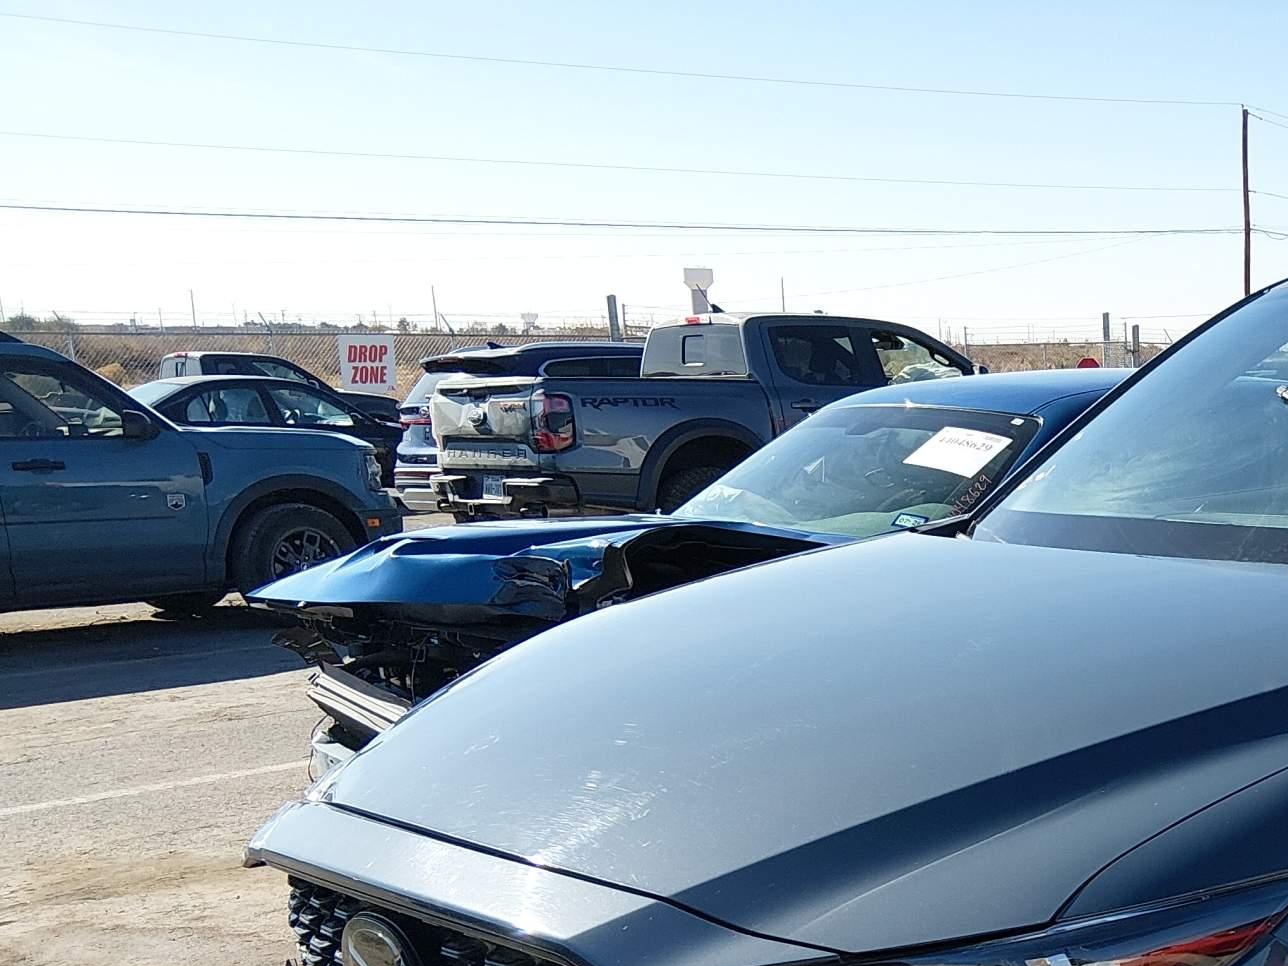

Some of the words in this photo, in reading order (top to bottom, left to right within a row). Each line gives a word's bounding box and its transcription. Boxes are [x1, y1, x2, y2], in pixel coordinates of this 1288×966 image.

[347, 344, 388, 363] DROP
[351, 365, 388, 385] ZONE
[580, 397, 681, 411] RAPTOR
